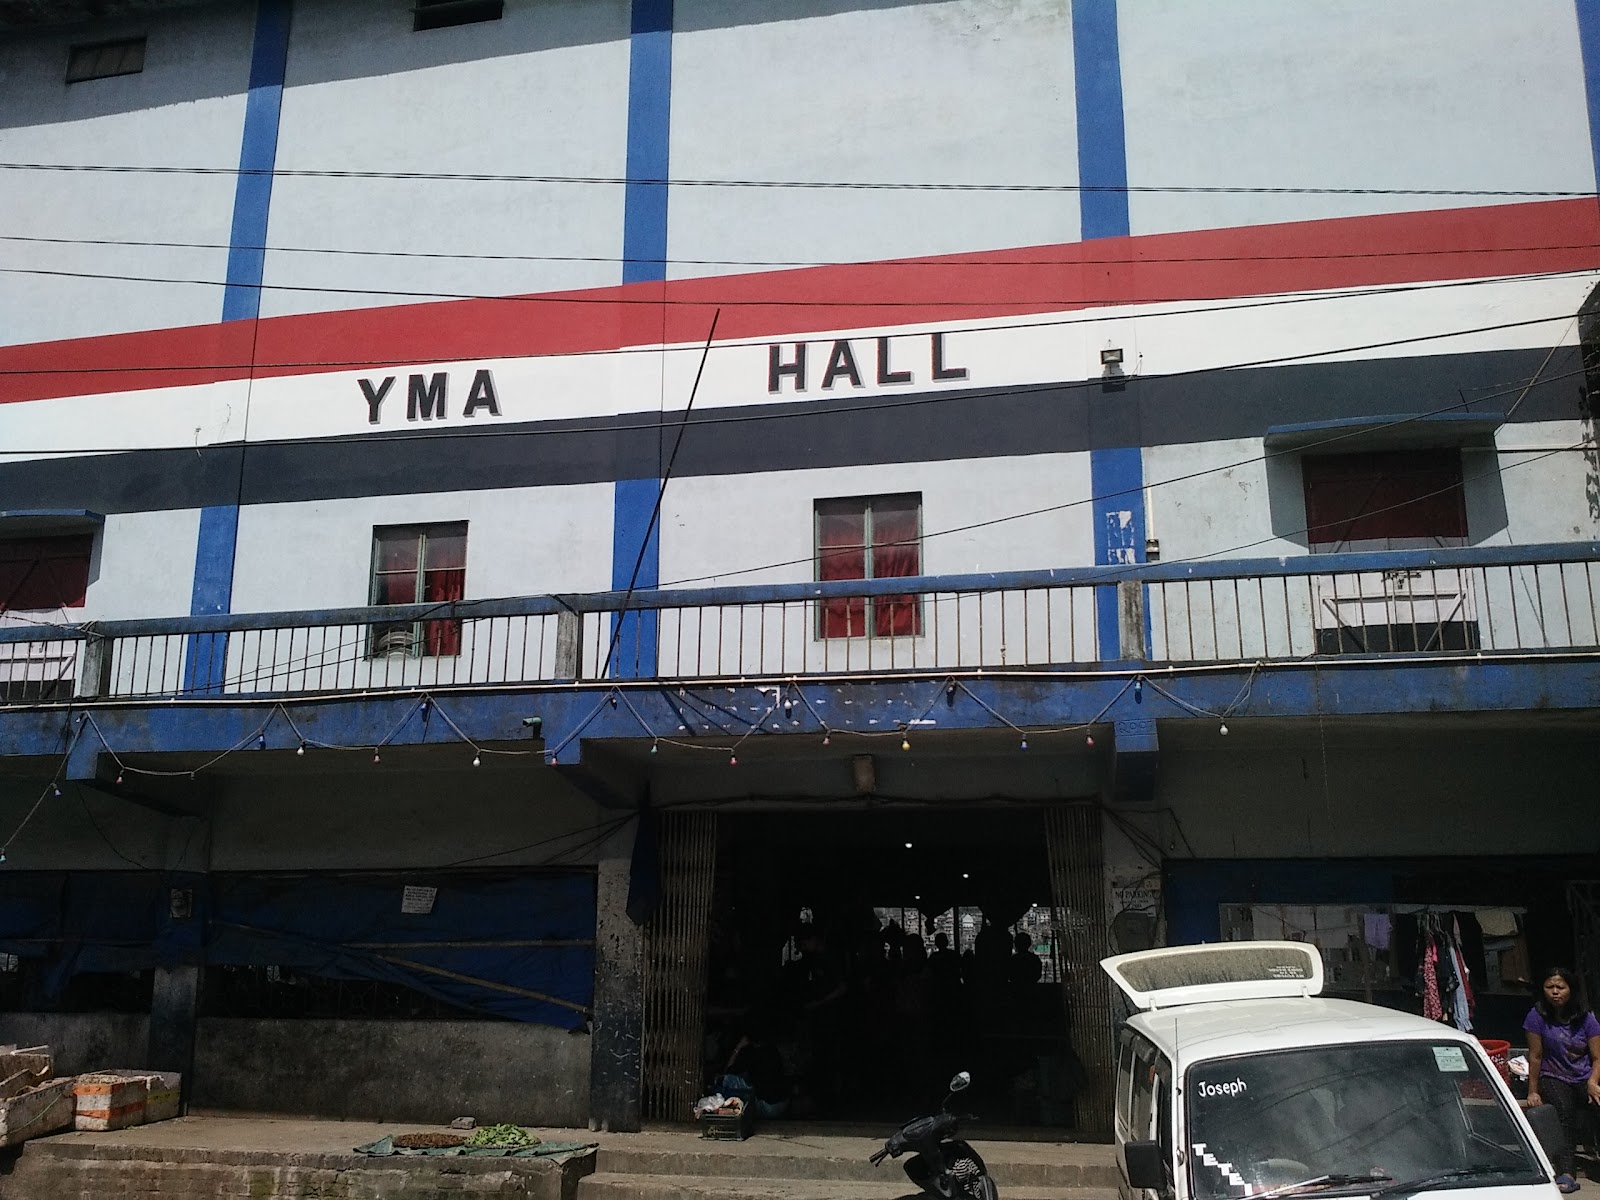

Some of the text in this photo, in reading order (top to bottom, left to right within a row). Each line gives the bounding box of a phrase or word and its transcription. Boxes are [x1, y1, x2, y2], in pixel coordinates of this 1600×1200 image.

[357, 333, 970, 425] YMA HALL
[1198, 1077, 1247, 1098] Joseph
